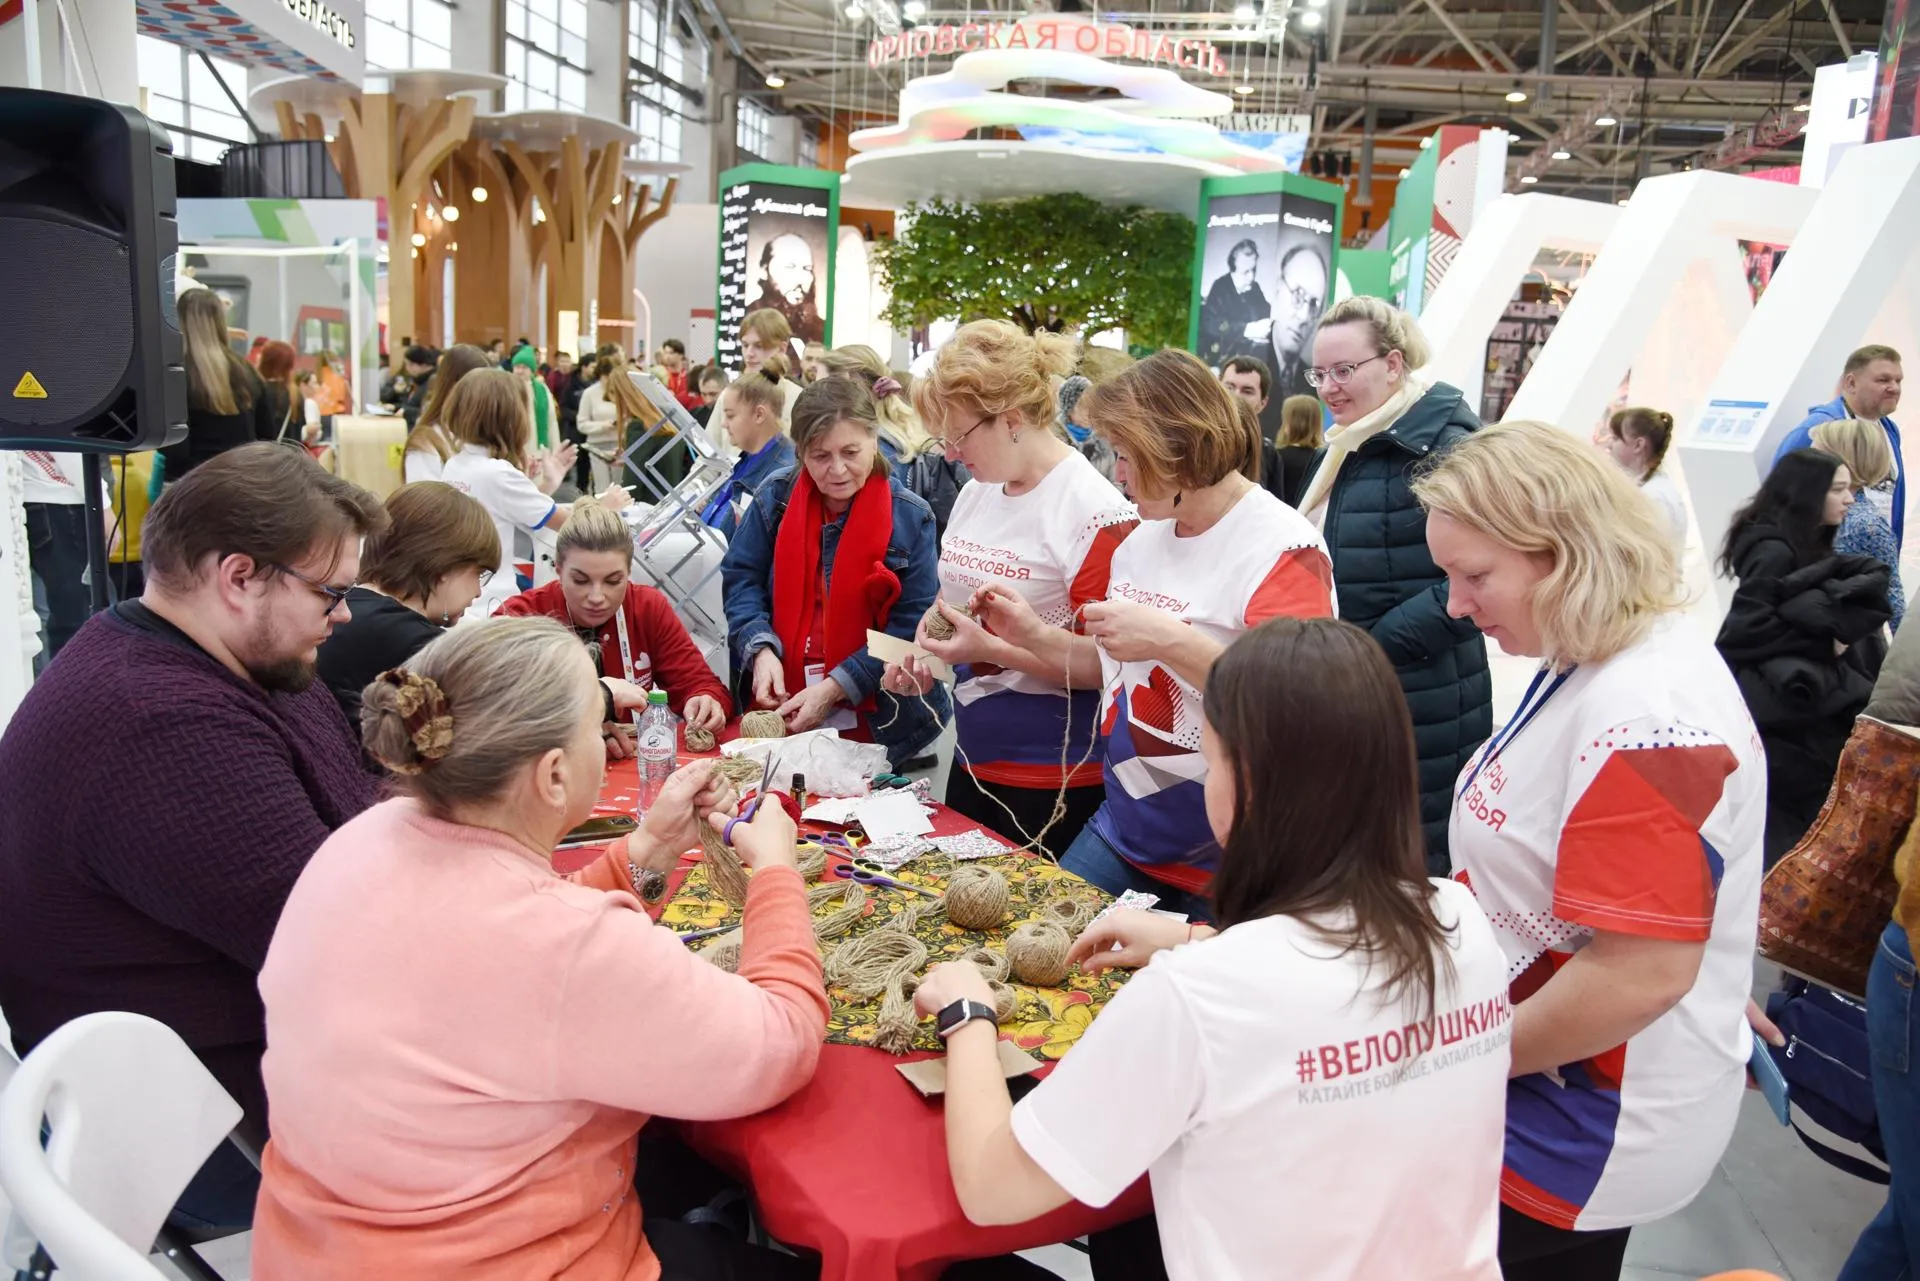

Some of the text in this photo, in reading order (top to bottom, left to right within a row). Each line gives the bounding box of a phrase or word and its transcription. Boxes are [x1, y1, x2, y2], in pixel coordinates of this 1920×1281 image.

[869, 23, 1230, 77] ОРЛОВСКАЯ ОБЛАСТЬ
[942, 548, 1031, 580] ДМОСКОВЬЯ
[945, 570, 957, 582] МЫ
[1113, 582, 1191, 613] ВОЛОНТЕРЫ
[1298, 1077, 1371, 1105] КАТАЙТЕ
[1433, 1041, 1482, 1072] КАТАЙТЕ
[1483, 1030, 1511, 1056] ДАЛЬ
